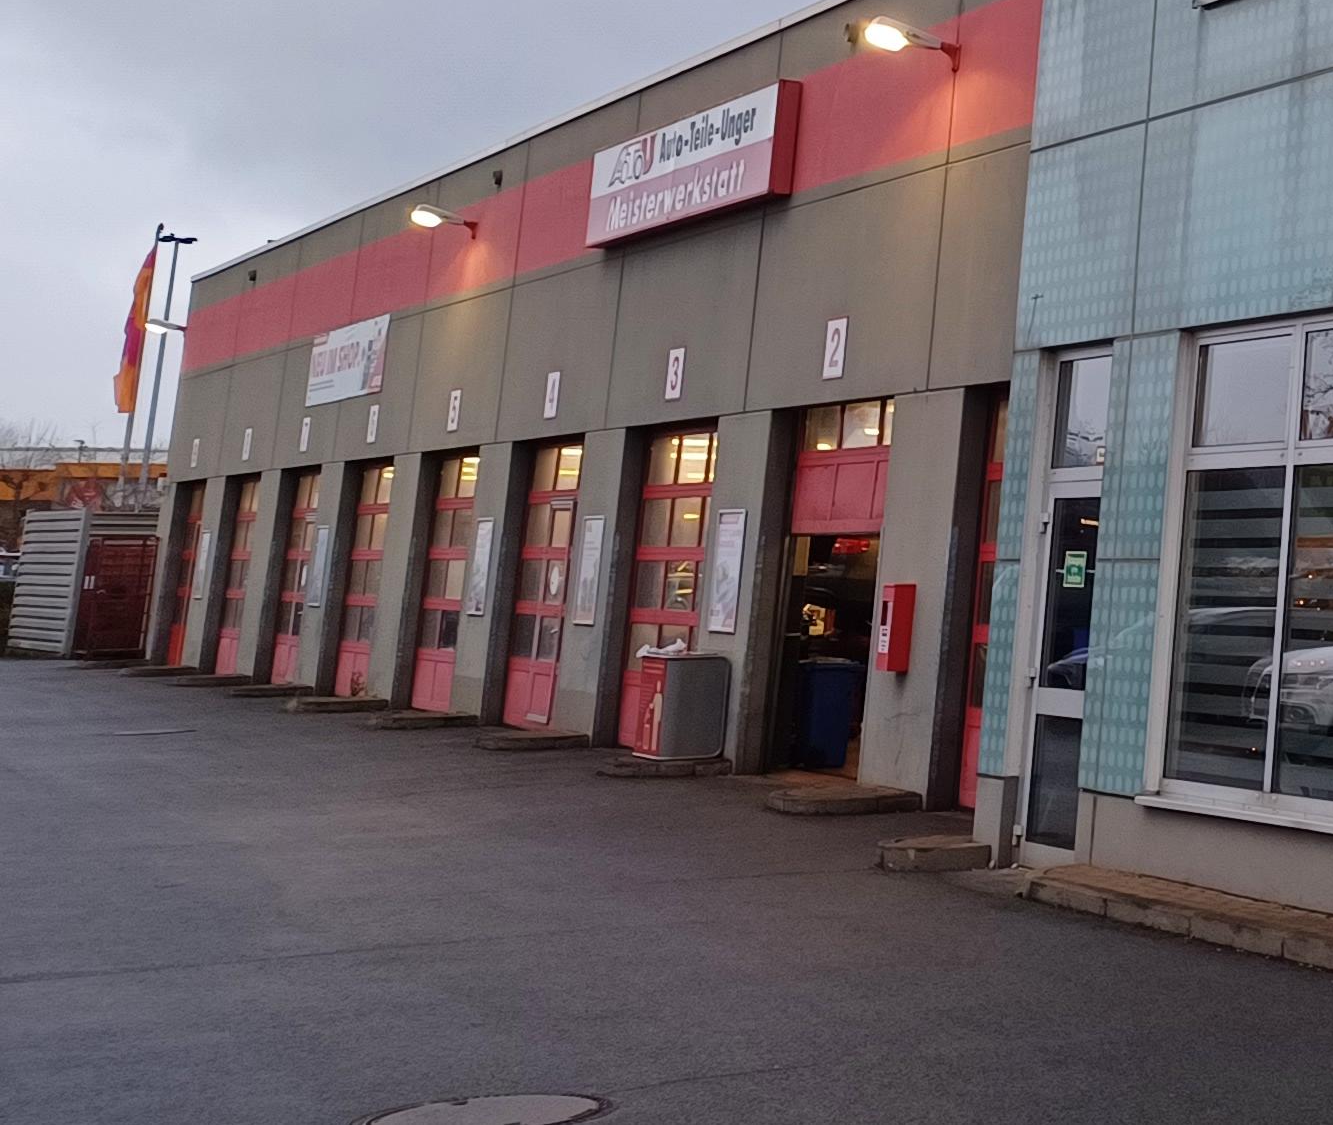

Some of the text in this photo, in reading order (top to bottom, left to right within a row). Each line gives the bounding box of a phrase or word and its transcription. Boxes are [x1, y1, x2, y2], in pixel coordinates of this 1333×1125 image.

[659, 107, 757, 164] Auto-Teile-Unger
[606, 159, 745, 232] Meisterwerkstatt
[828, 327, 841, 368] 2
[669, 356, 681, 392] 3
[450, 395, 459, 424] 5
